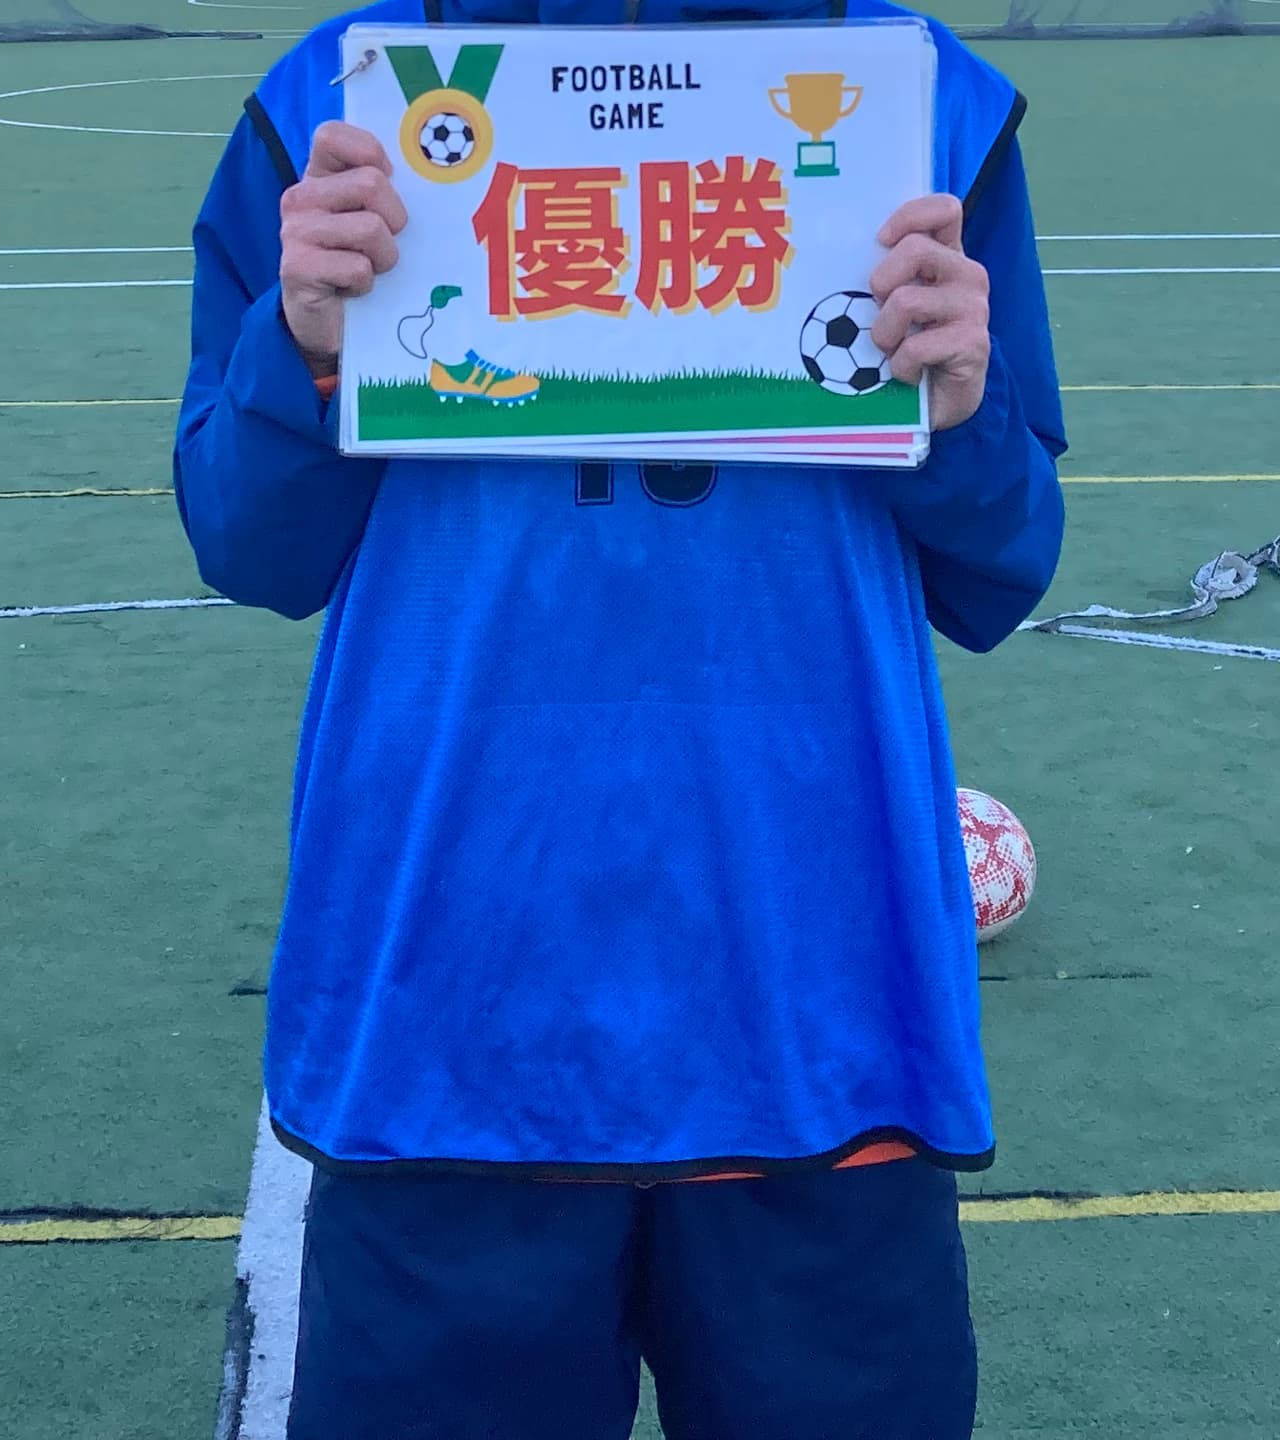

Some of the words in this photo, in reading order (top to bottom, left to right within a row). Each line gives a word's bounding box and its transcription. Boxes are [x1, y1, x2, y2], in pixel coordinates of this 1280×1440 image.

[551, 62, 701, 92] FOOTBALL
[589, 103, 664, 130] GAME
[472, 156, 793, 320] 優勝
